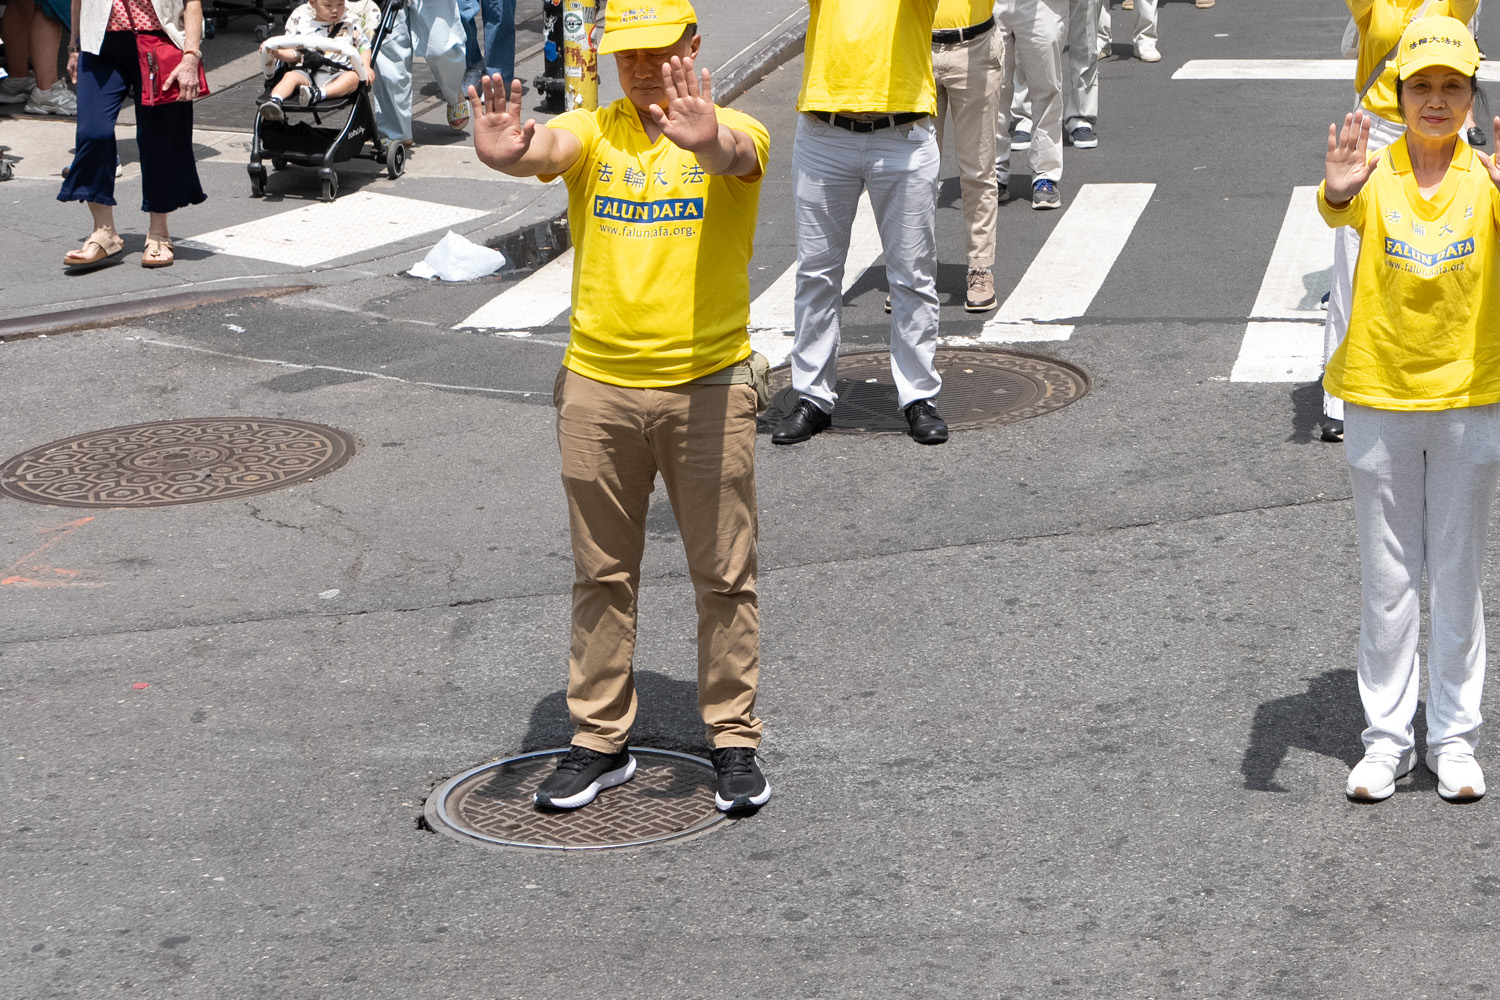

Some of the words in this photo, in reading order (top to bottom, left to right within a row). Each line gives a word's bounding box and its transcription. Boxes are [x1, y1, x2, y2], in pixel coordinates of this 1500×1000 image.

[1409, 36, 1462, 50] 法輪大法好
[596, 161, 706, 190] 法輪大法
[595, 198, 649, 221] FALUN
[652, 201, 699, 219] DAFA
[1386, 239, 1433, 266] FALUN
[1436, 241, 1474, 263] DAFA
